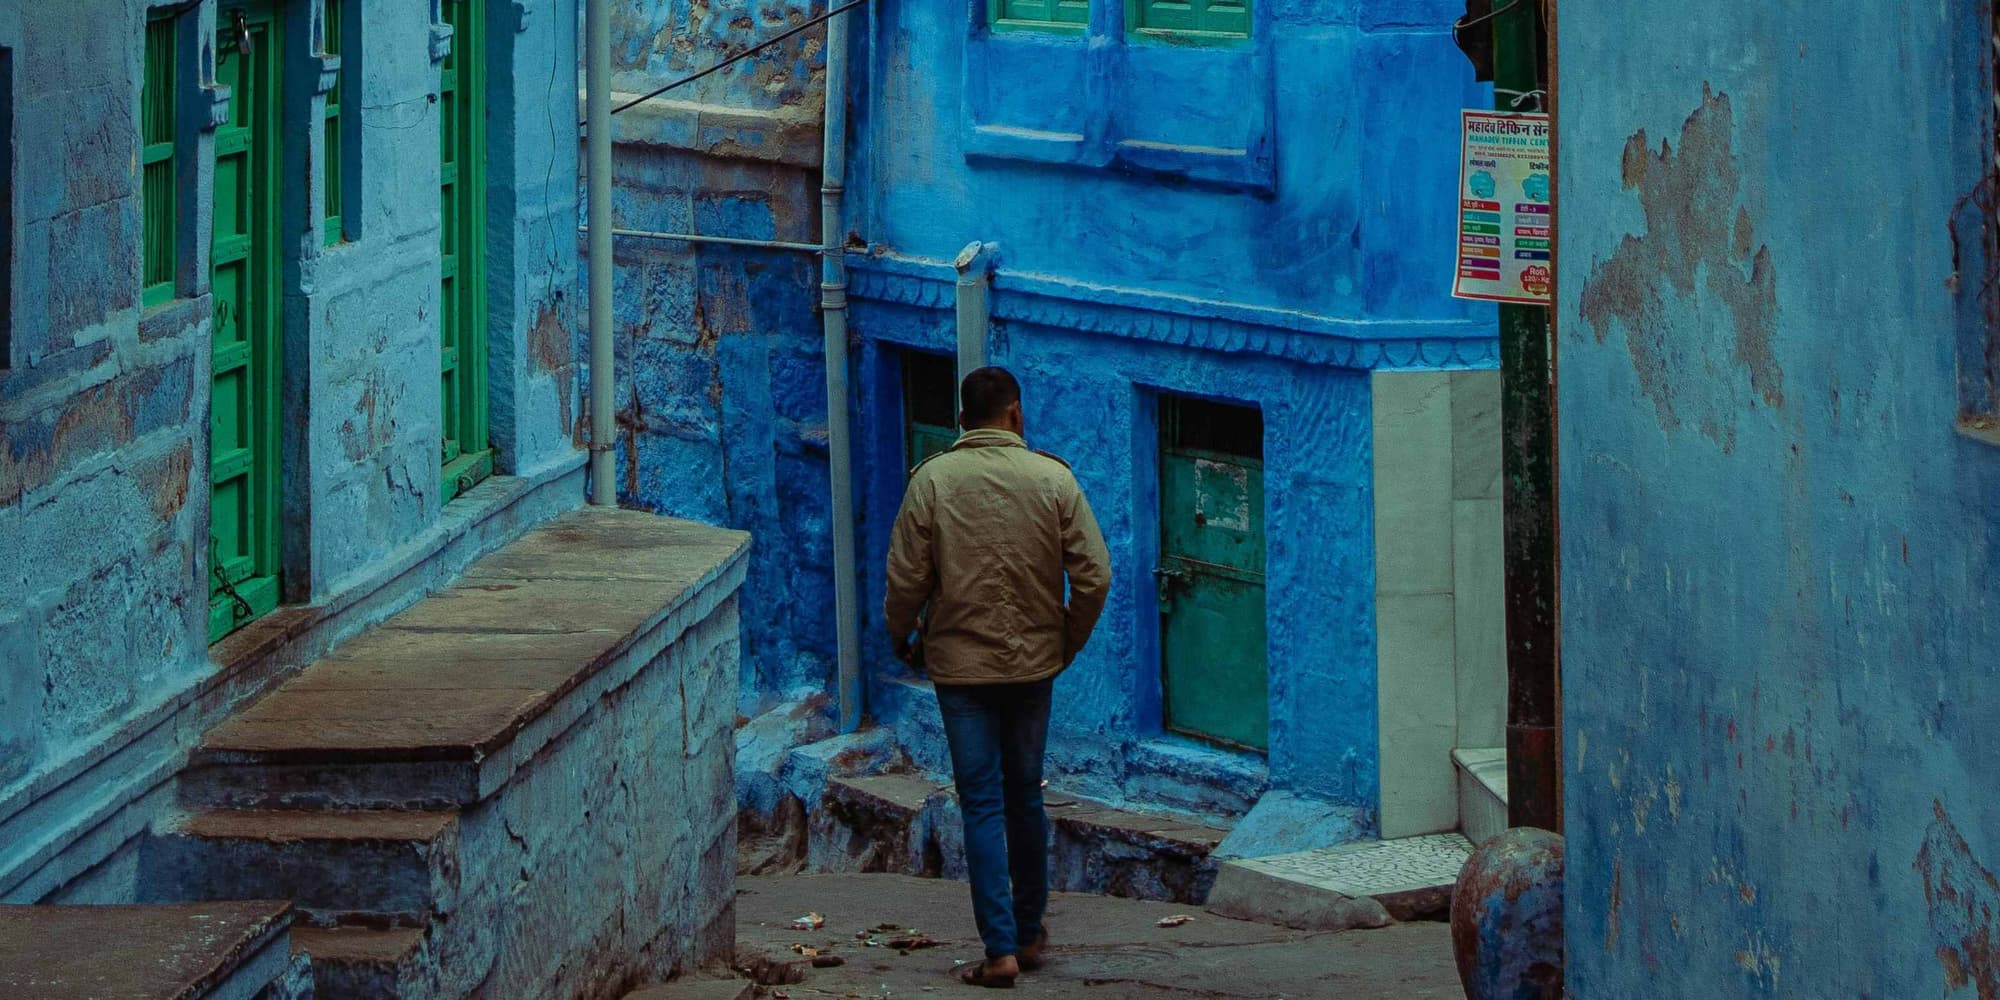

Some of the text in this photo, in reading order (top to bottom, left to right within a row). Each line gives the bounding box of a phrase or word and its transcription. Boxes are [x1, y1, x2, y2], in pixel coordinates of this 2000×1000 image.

[1468, 119, 1496, 134] महादेव
[1496, 120, 1531, 136] टिफिन
[1469, 135, 1500, 143] MAHADEV
[1502, 137, 1527, 145] TIFFIN
[1530, 266, 1545, 275] Roti
